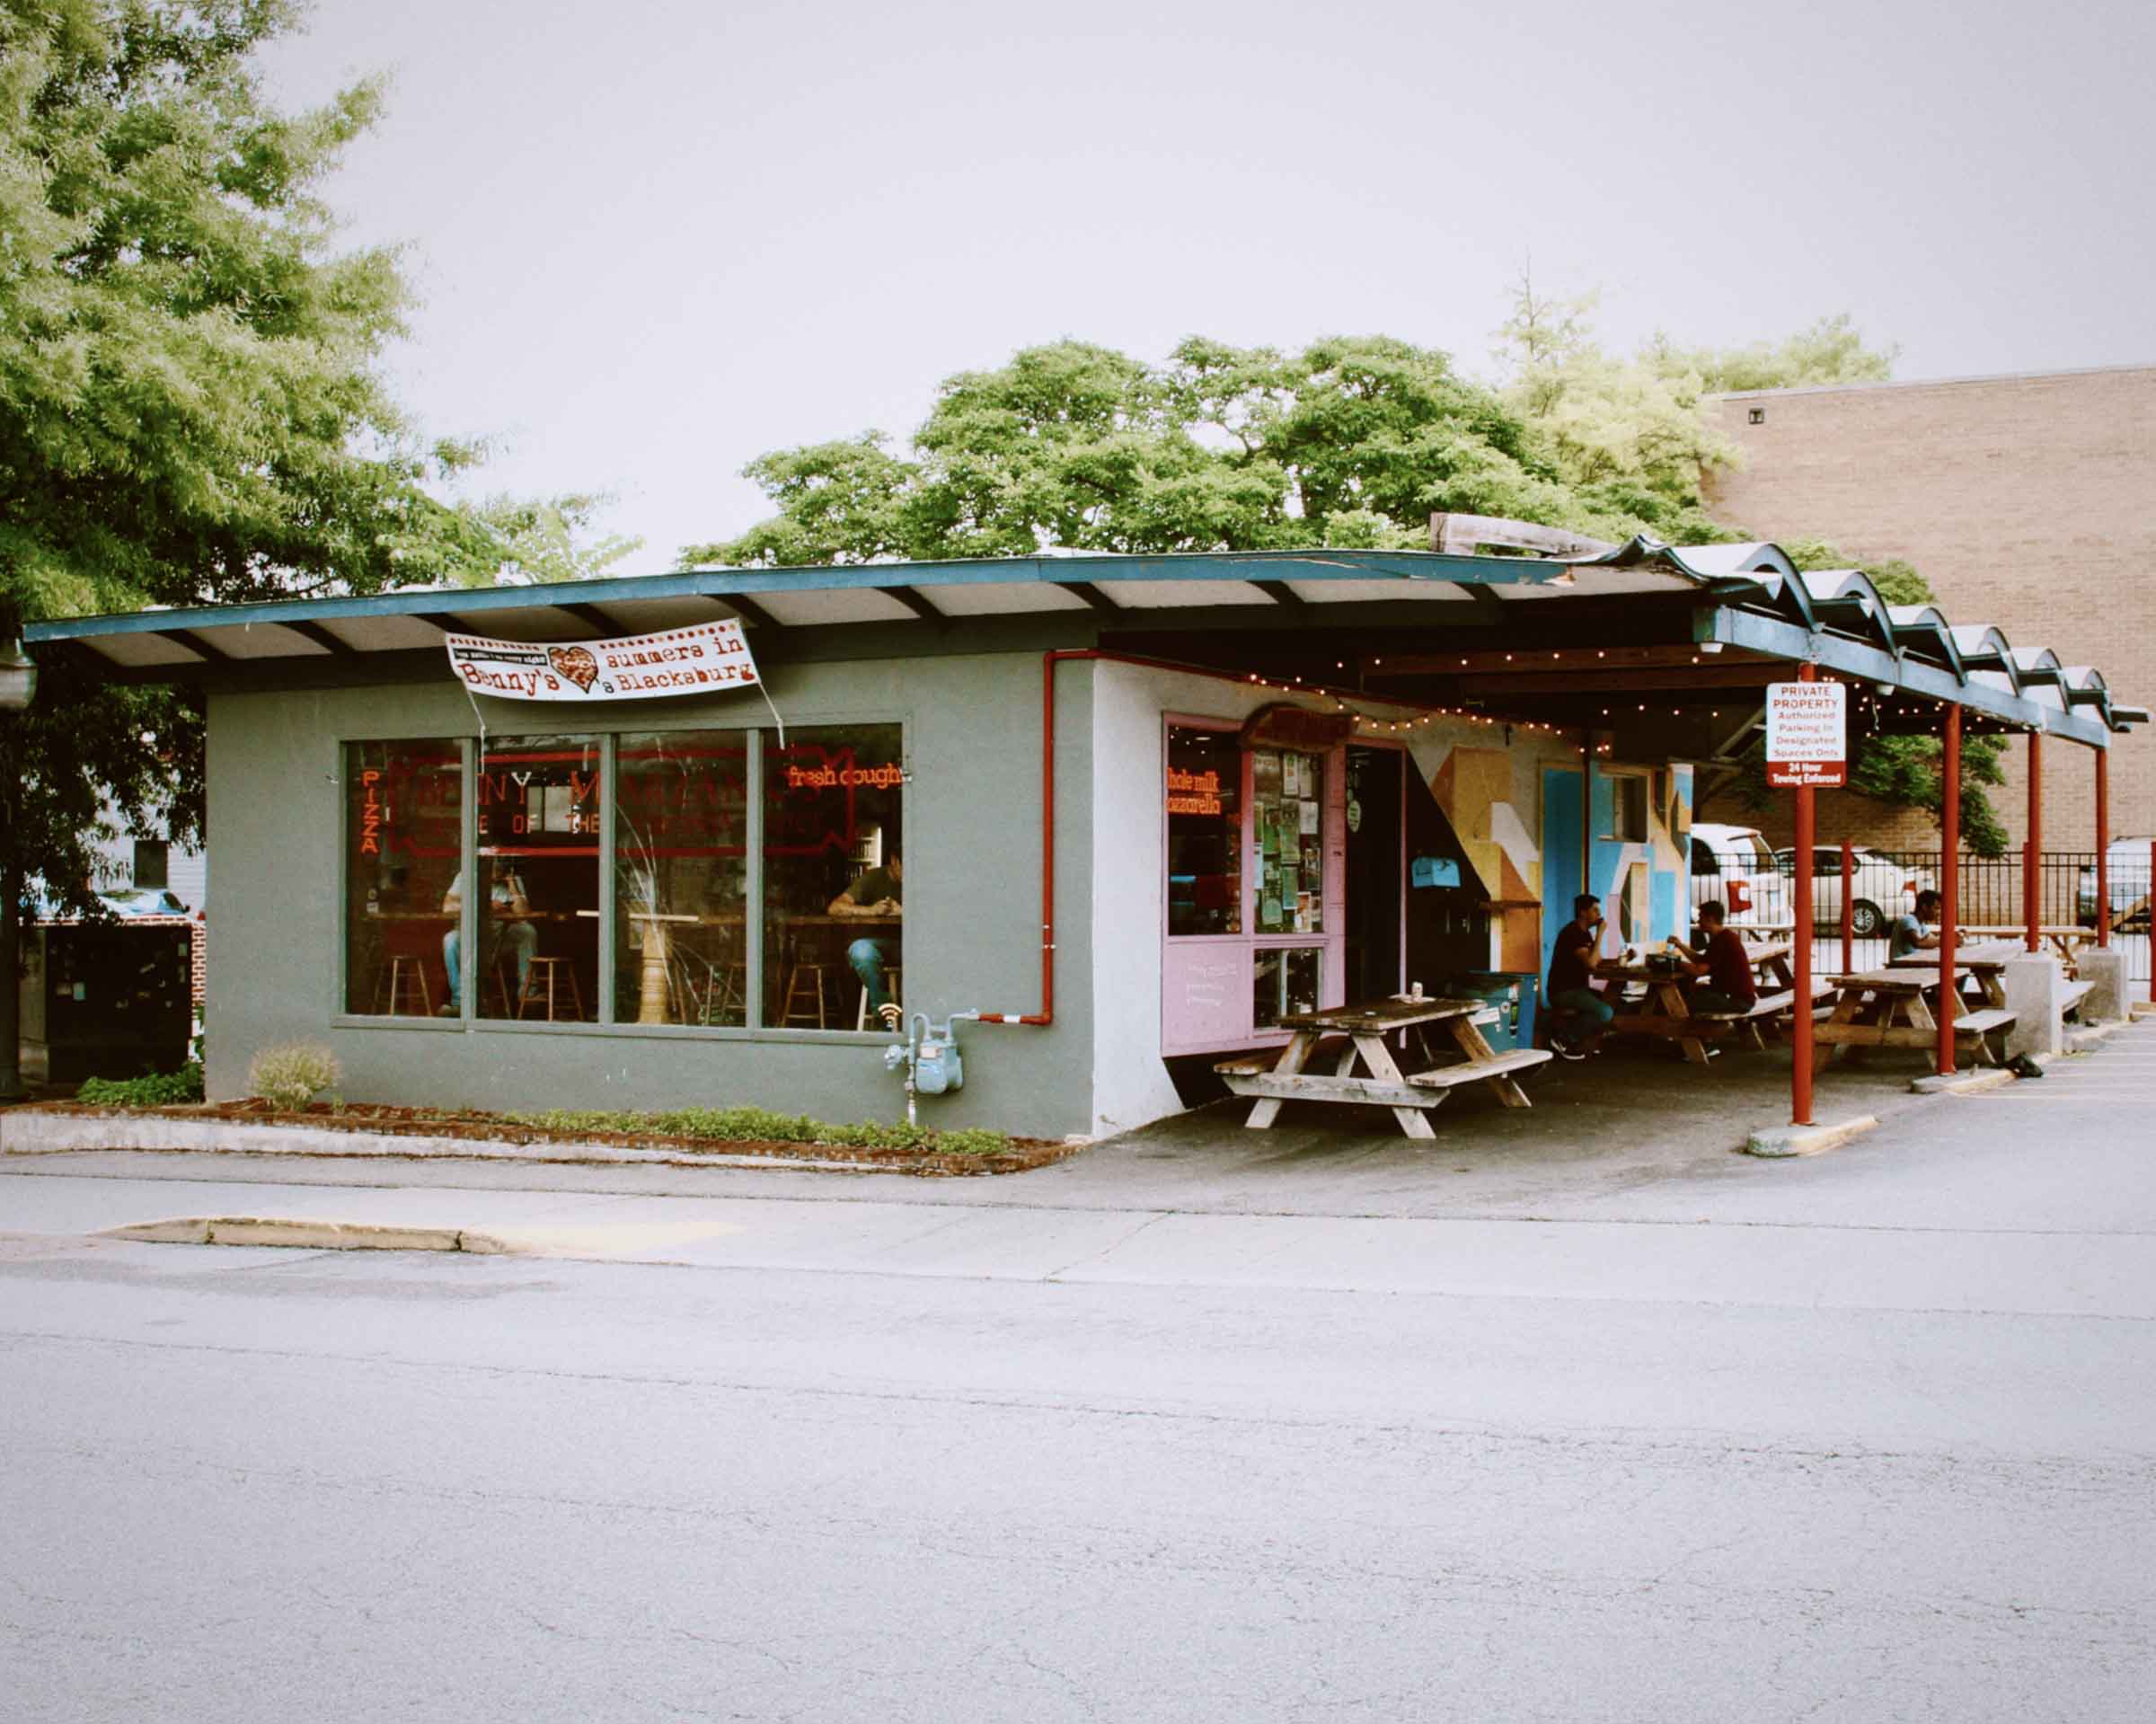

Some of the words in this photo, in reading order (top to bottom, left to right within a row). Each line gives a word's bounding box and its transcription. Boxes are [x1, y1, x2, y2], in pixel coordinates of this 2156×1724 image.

[605, 644, 704, 669] summers
[714, 636, 744, 656] in
[458, 662, 561, 697] Benny's
[614, 661, 756, 692] Blacksburg
[1781, 686, 1830, 696] PRIVATE
[1773, 699, 1839, 709] PROPERTY
[790, 765, 837, 787] fresh
[1789, 763, 1800, 773] 24
[360, 770, 380, 855] PIZZA
[511, 813, 538, 835] OF
